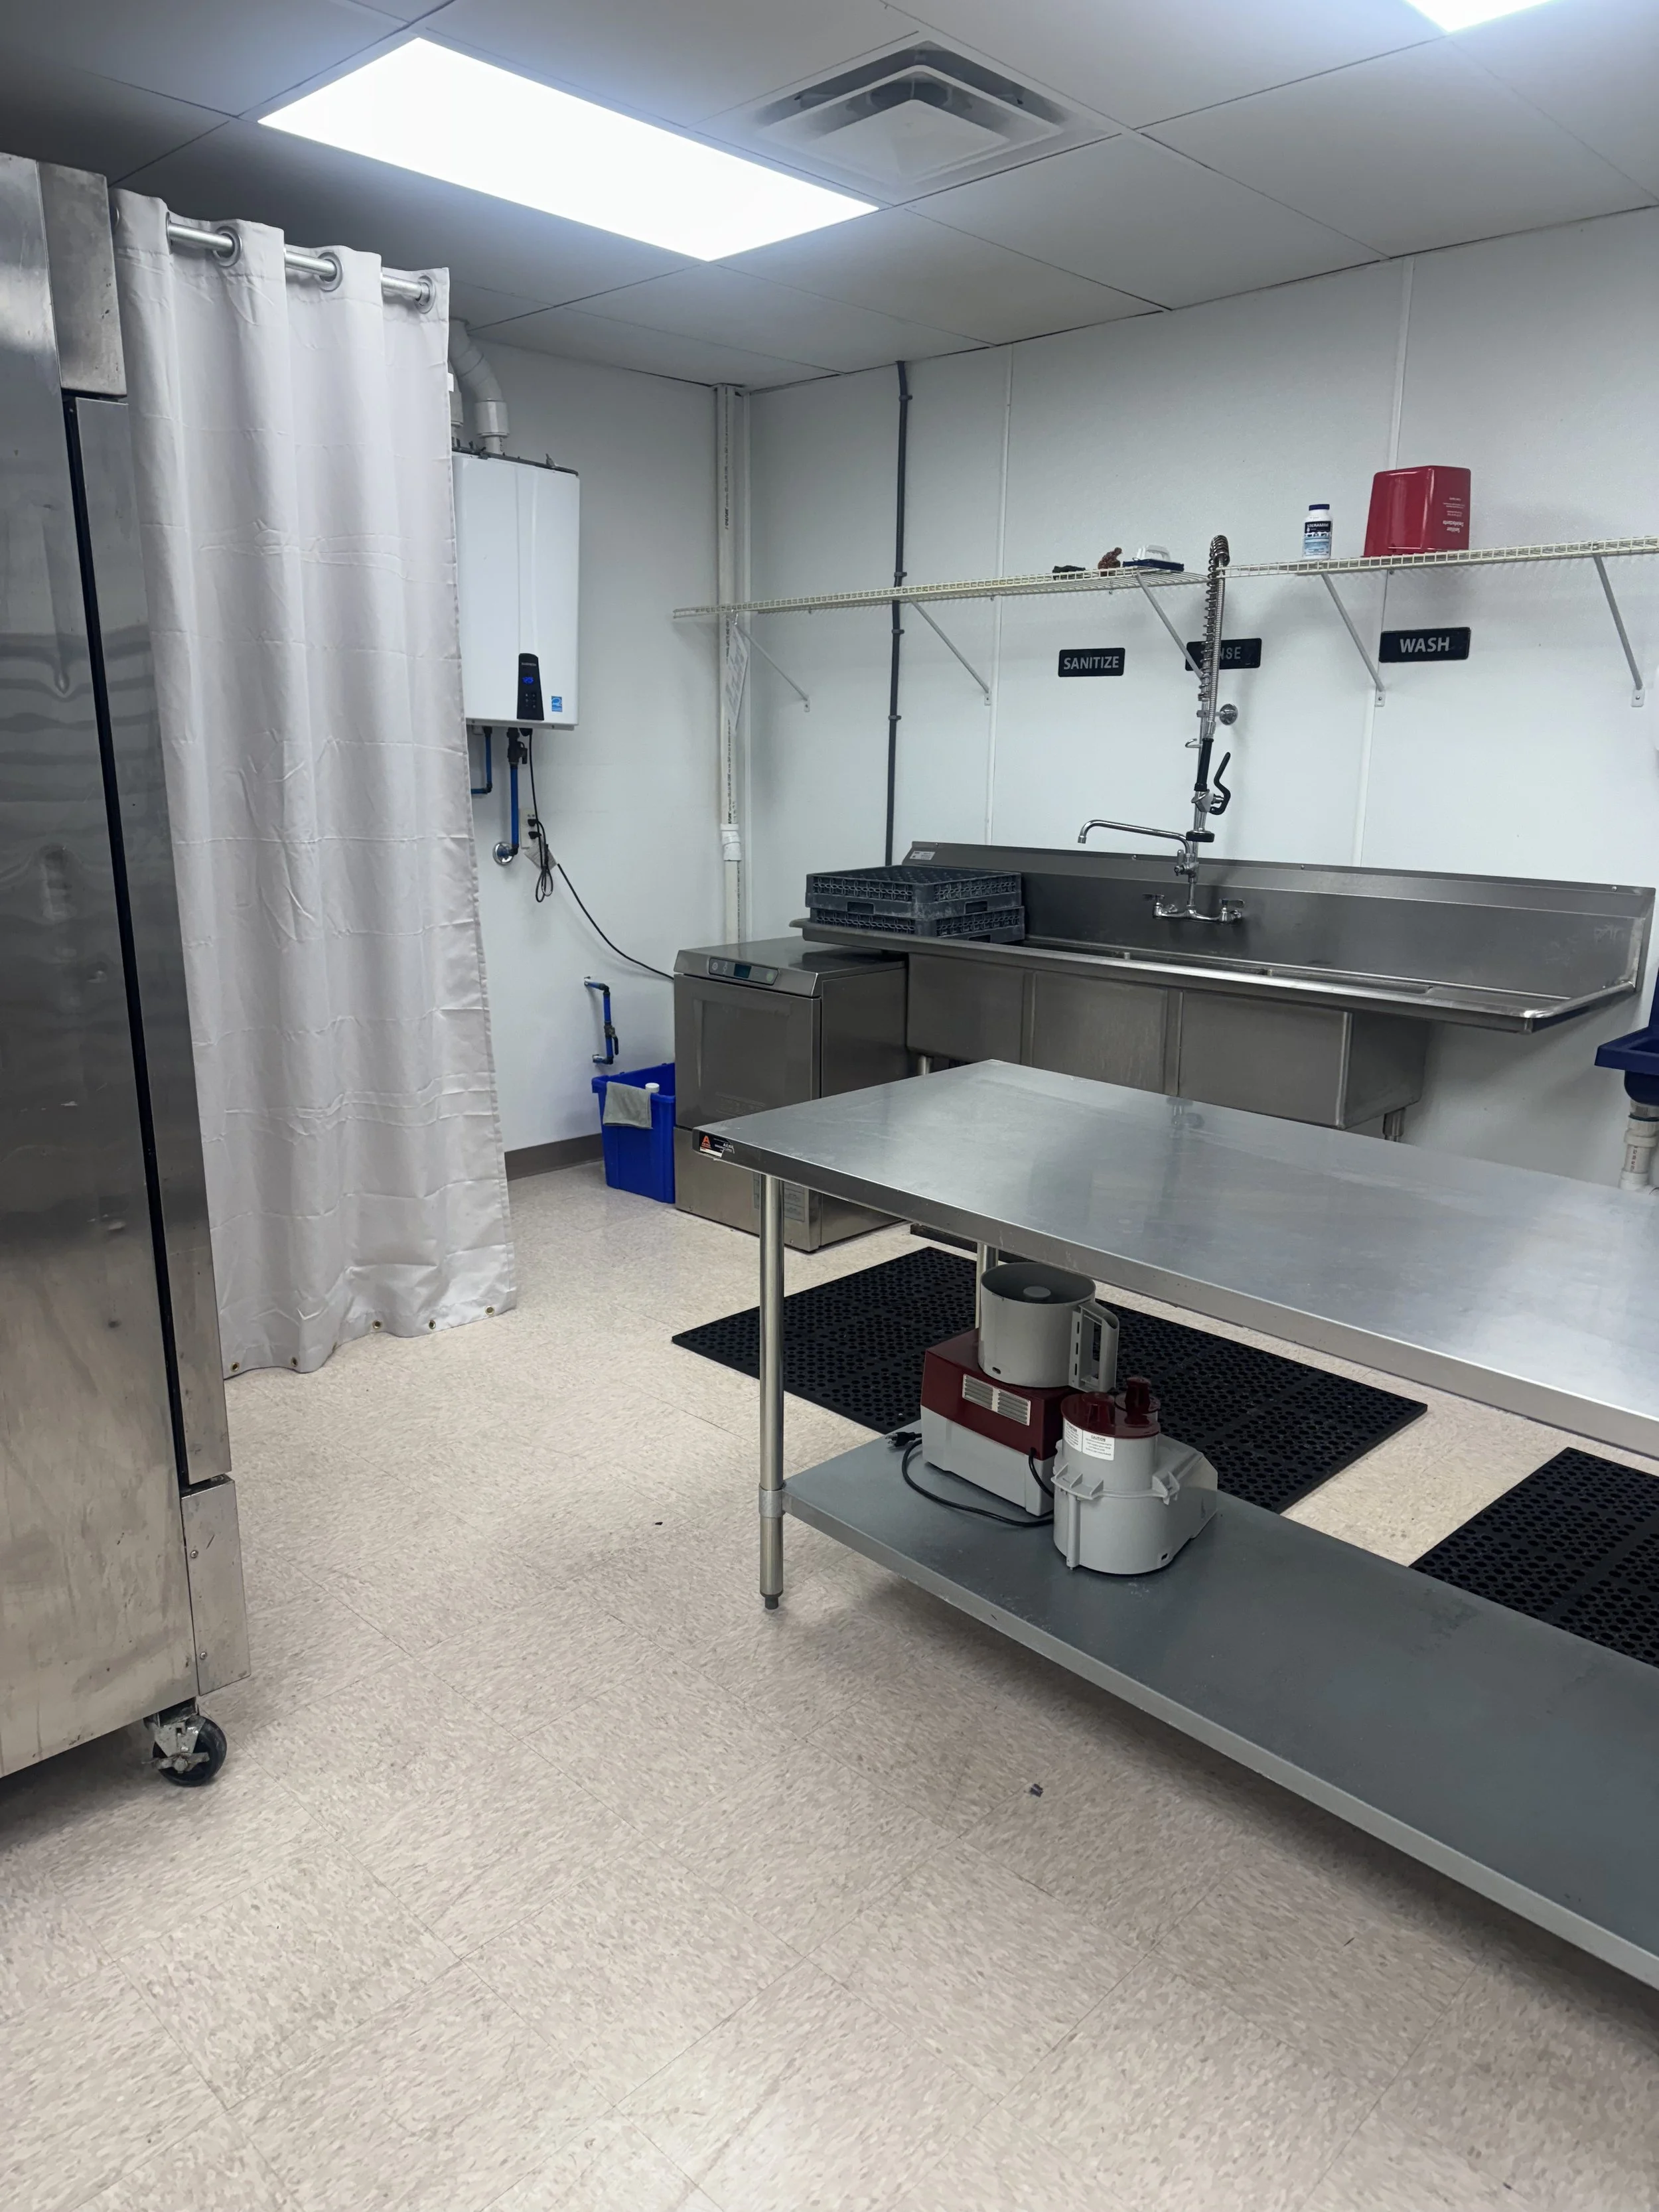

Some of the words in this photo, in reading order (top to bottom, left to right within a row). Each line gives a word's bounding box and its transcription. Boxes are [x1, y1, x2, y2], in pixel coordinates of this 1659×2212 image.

[1399, 636, 1450, 653] WASH
[1218, 646, 1242, 660] NSE
[1063, 656, 1119, 670] SANITIZE
